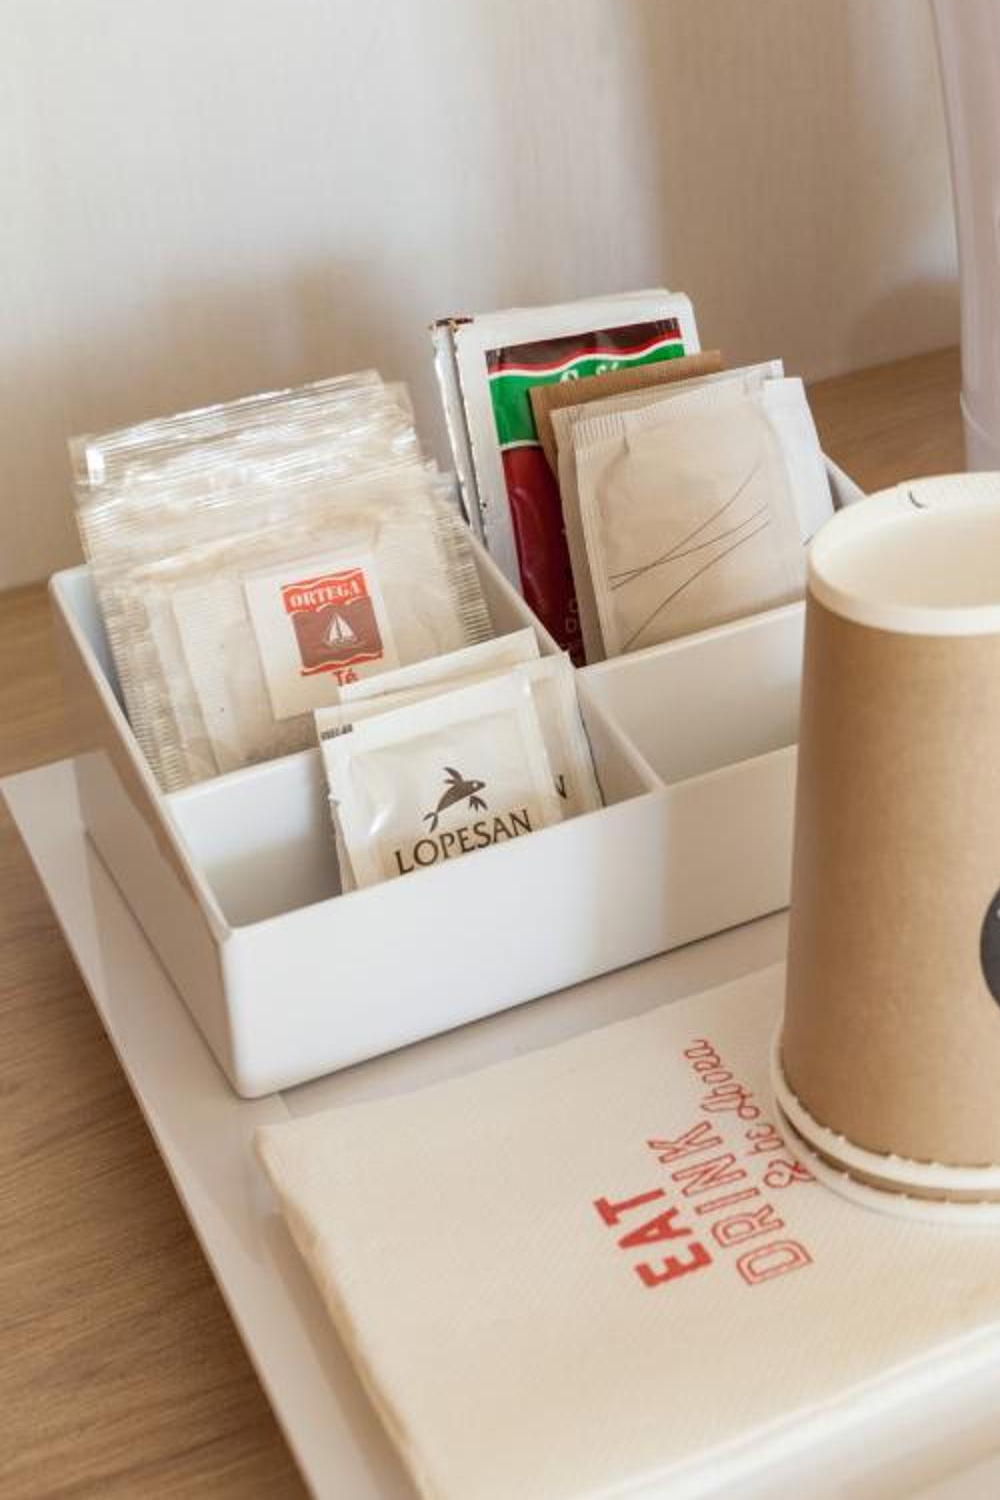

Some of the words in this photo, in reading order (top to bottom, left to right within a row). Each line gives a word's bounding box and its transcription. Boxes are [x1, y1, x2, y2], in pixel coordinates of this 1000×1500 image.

[290, 579, 361, 608] ORTEGA
[393, 808, 533, 876] LOPESAN
[647, 1121, 814, 1286] DRINK
[763, 1159, 818, 1189] &
[594, 1188, 713, 1287] EAT
